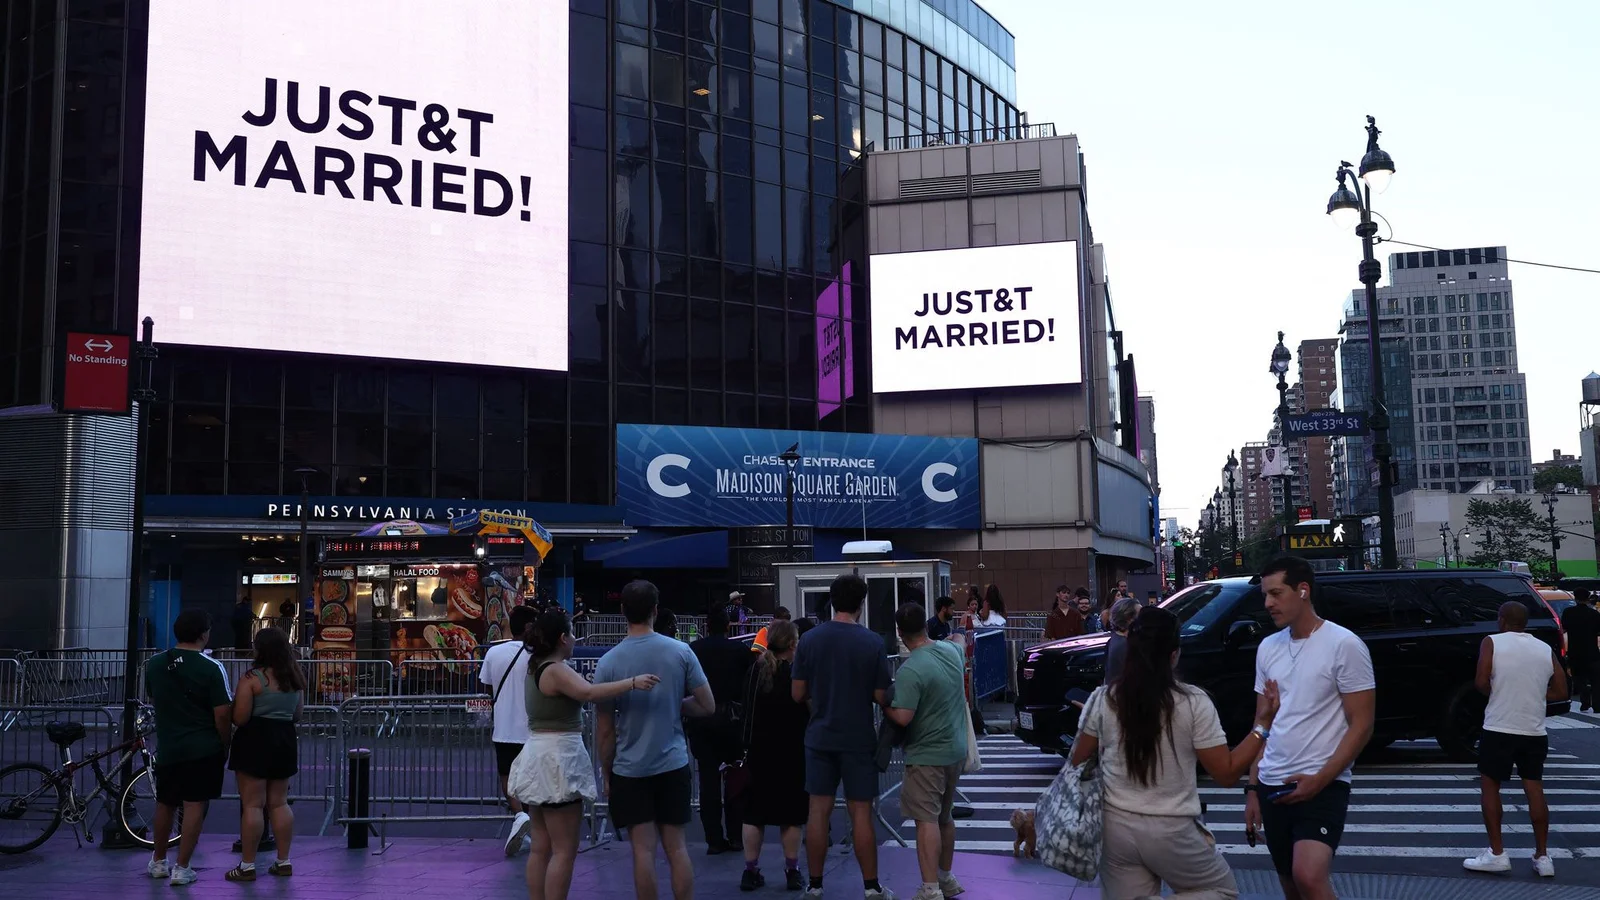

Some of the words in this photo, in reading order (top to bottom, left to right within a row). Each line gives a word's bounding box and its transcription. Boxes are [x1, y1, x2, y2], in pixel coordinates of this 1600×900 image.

[242, 77, 493, 157] JUST&T
[193, 130, 531, 222] MARRIED!
[914, 286, 1033, 317] JUST&T
[895, 318, 1055, 350] MARRIED!
[69, 354, 82, 362] No
[85, 355, 127, 367] Standing
[1289, 420, 1319, 432] West
[1322, 417, 1344, 430] 33rd
[1347, 418, 1360, 429] St
[743, 455, 785, 466] CHASE
[803, 456, 875, 469] ENTRANCE
[716, 468, 782, 493] MADISON
[483, 514, 530, 527] SABRETT
[775, 529, 809, 542] STTION
[1292, 534, 1331, 547] TAX
[322, 569, 354, 577] SAMMY'S
[393, 569, 417, 577] HALAL
[418, 568, 440, 576] FOOD
